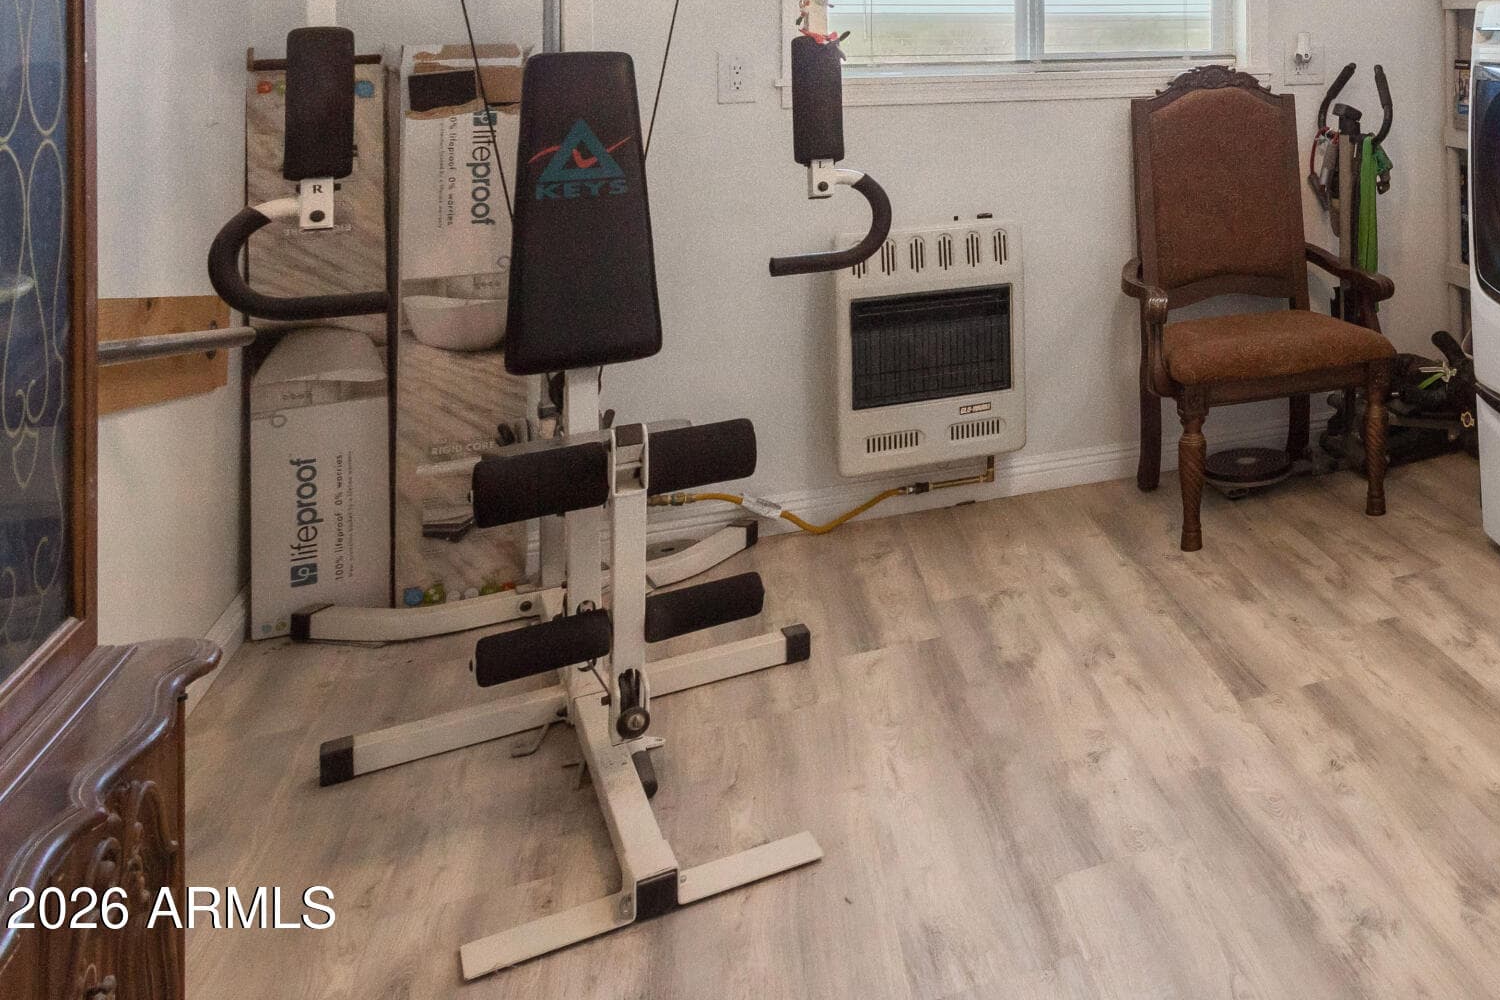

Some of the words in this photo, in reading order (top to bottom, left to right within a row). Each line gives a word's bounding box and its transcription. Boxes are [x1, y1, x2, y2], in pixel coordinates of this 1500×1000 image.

[312, 184, 323, 194] R
[466, 129, 496, 225] lifeproof
[535, 180, 627, 201] KEYS
[289, 458, 324, 562] lifeproof
[335, 491, 342, 506] 0%
[335, 513, 343, 553] lifeproof
[335, 557, 343, 581] 100%
